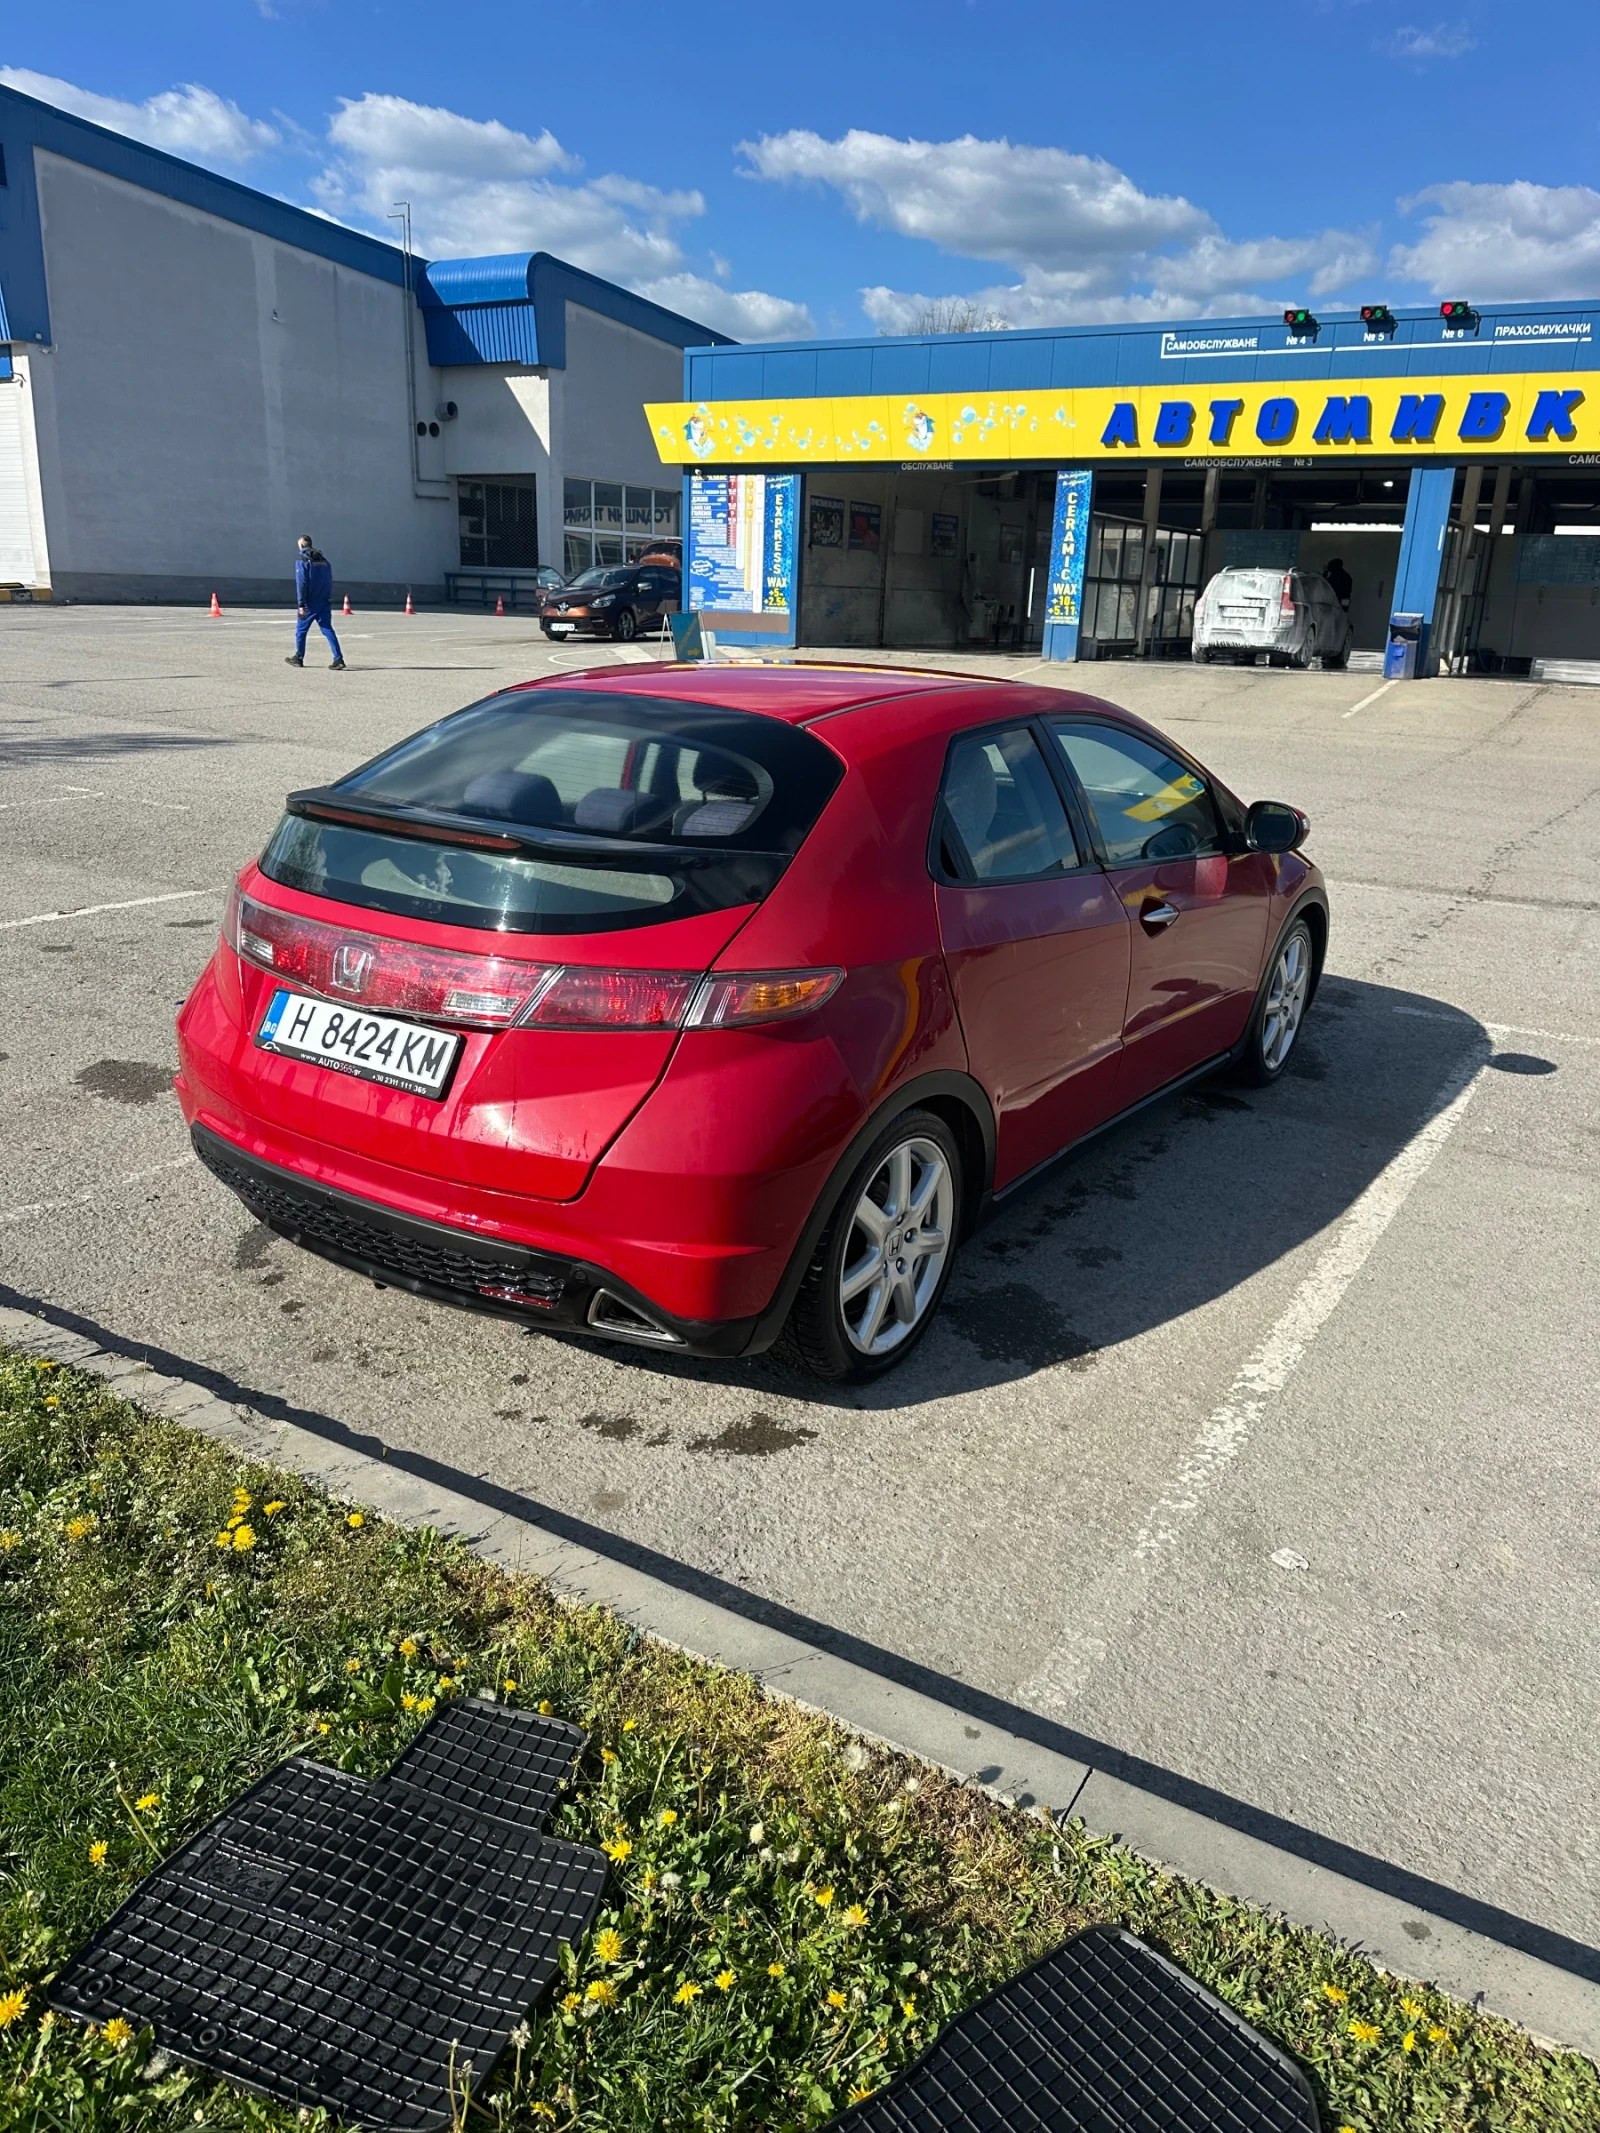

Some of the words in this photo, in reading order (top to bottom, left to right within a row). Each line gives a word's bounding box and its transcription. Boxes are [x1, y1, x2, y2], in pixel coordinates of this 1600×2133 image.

[1457, 329, 1464, 338] 6
[1495, 323, 1591, 337] ПРАХОСМУКАЧКИ
[1377, 332, 1385, 342] 5
[1166, 338, 1258, 351] САМООБСЛУЖВАНЕ
[1299, 336, 1306, 345] 4
[1100, 389, 1600, 447] АВТОМИВК
[901, 462, 954, 471] ОБСЛУЖВАНЕ
[1184, 458, 1282, 468] САМООБСЛУЖВАНЕ
[1307, 457, 1313, 466] 3
[773, 494, 784, 574] EXPRESS
[1060, 492, 1079, 580] CERAMIC
[767, 577, 788, 588] WAX
[1053, 583, 1078, 595] WAX
[264, 1021, 278, 1034] BG
